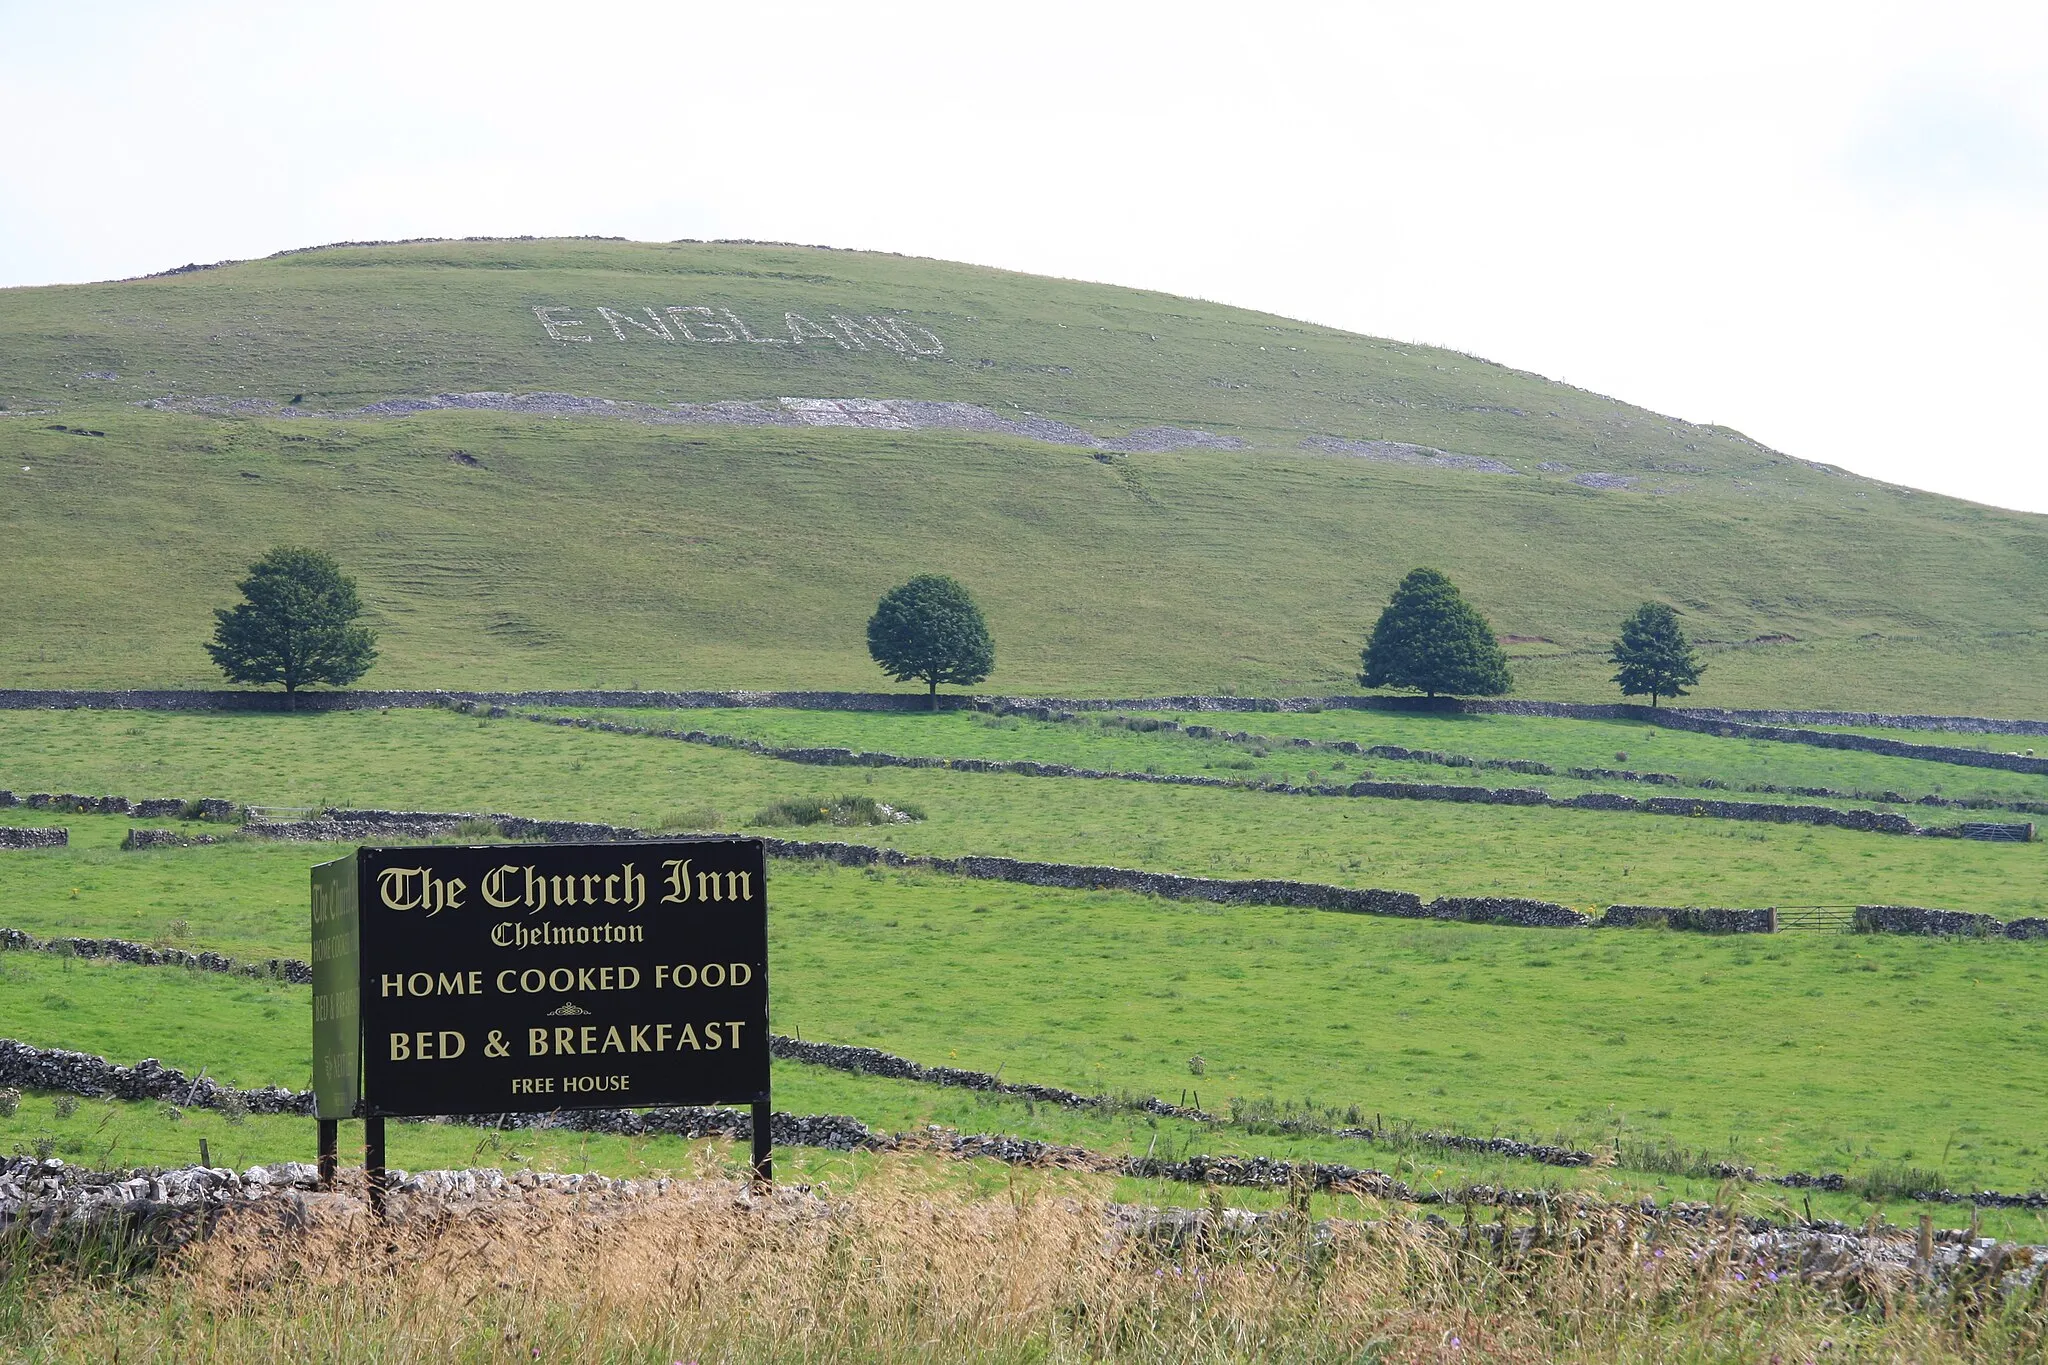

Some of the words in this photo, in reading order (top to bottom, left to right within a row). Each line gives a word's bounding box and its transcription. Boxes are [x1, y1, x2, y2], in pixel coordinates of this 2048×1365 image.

[531, 305, 945, 356] ENGLAND
[376, 865, 467, 918] The
[481, 862, 646, 915] Church
[660, 858, 754, 904] Inn
[490, 921, 644, 951] Chelmorton
[381, 971, 483, 998] HOME
[496, 966, 640, 994] COOKED
[655, 962, 752, 989] FOOD
[390, 1031, 466, 1061] BED
[483, 1029, 511, 1058] &
[528, 1021, 746, 1056] BREAKFAST
[512, 1077, 554, 1094] FREE
[563, 1075, 630, 1092] HOUSE
